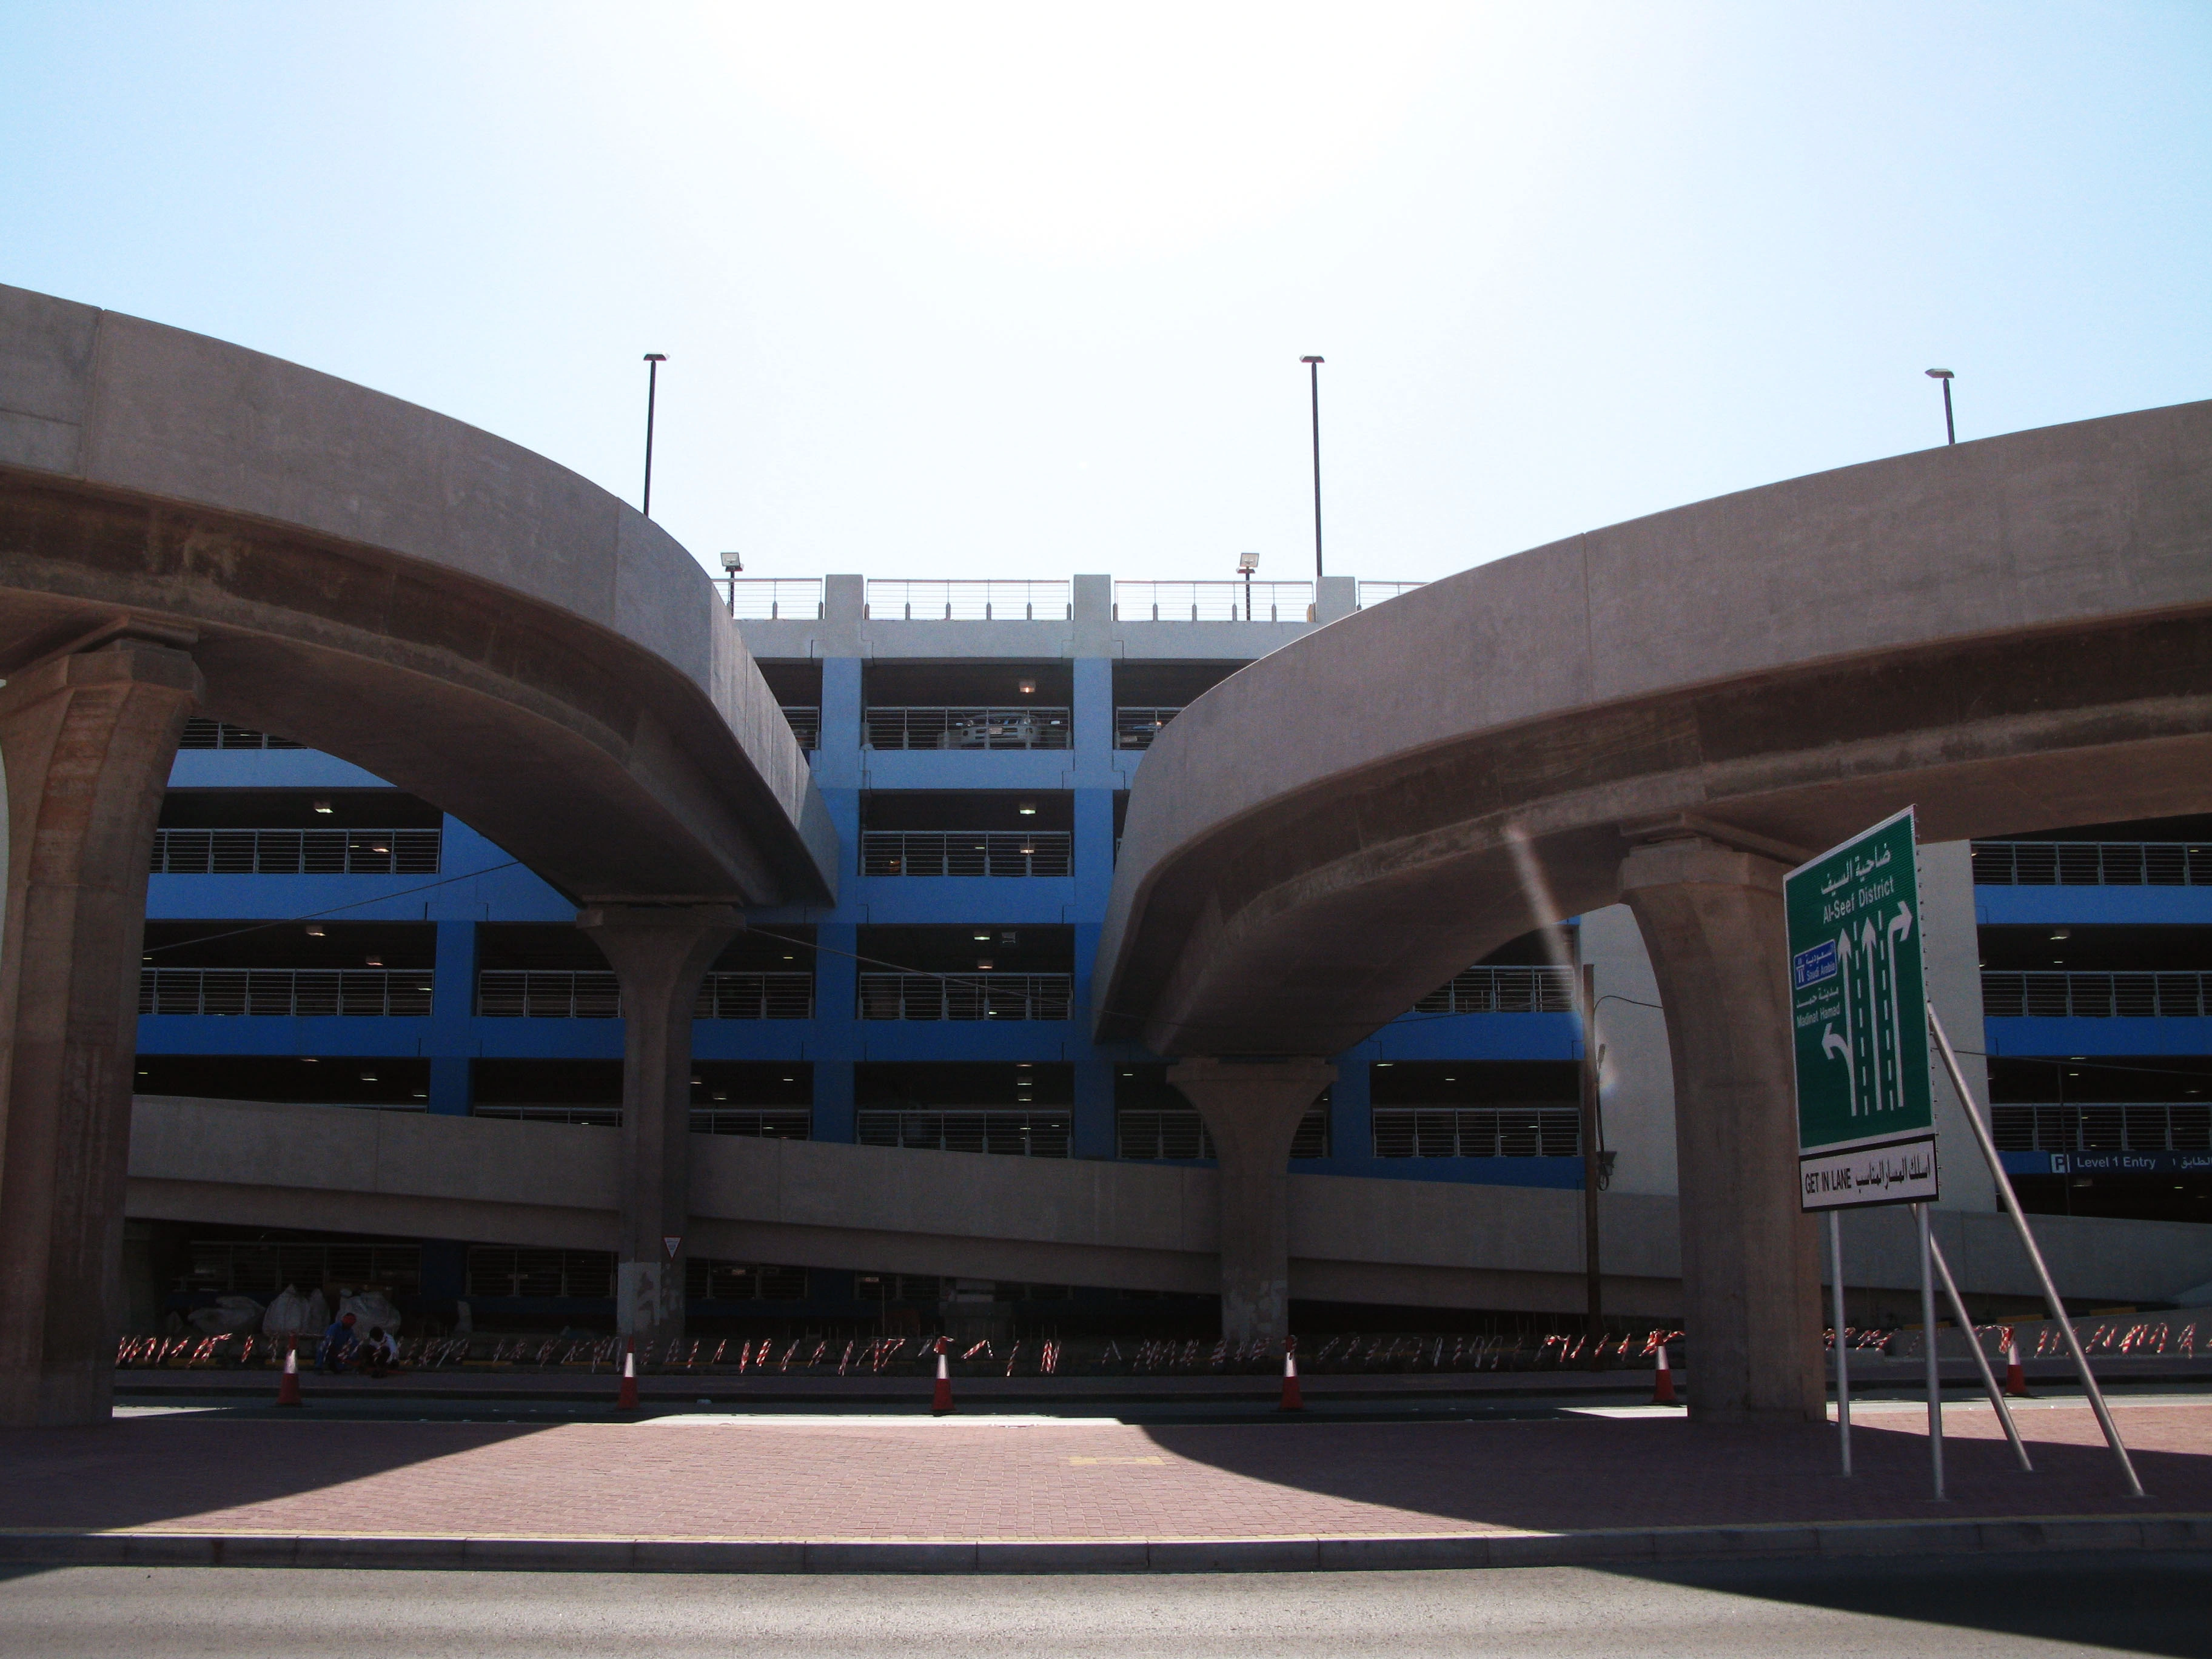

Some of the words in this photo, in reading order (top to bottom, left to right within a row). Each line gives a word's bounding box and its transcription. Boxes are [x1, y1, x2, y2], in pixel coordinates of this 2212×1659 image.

[1855, 843, 1891, 882] ضاحية
[1821, 859, 1852, 896] السيف
[1823, 893, 1855, 923] Al-Seef
[1858, 876, 1894, 907] District
[1806, 967, 1820, 981] Saudi
[1820, 961, 1835, 976] Arabia
[1818, 987, 1839, 1001] مدينة
[1820, 1002, 1840, 1021] Hamad
[1855, 1159, 1884, 1193] المناسب
[1885, 1156, 1907, 1190] المسار
[1909, 1153, 1930, 1181] اسلك
[2077, 1156, 2109, 1168] Level
[2113, 1156, 2119, 1167] 1
[2123, 1156, 2156, 1170] Entry
[1805, 1172, 1819, 1194] GET
[1822, 1171, 1829, 1191] IN
[1832, 1168, 1852, 1190] LANE
